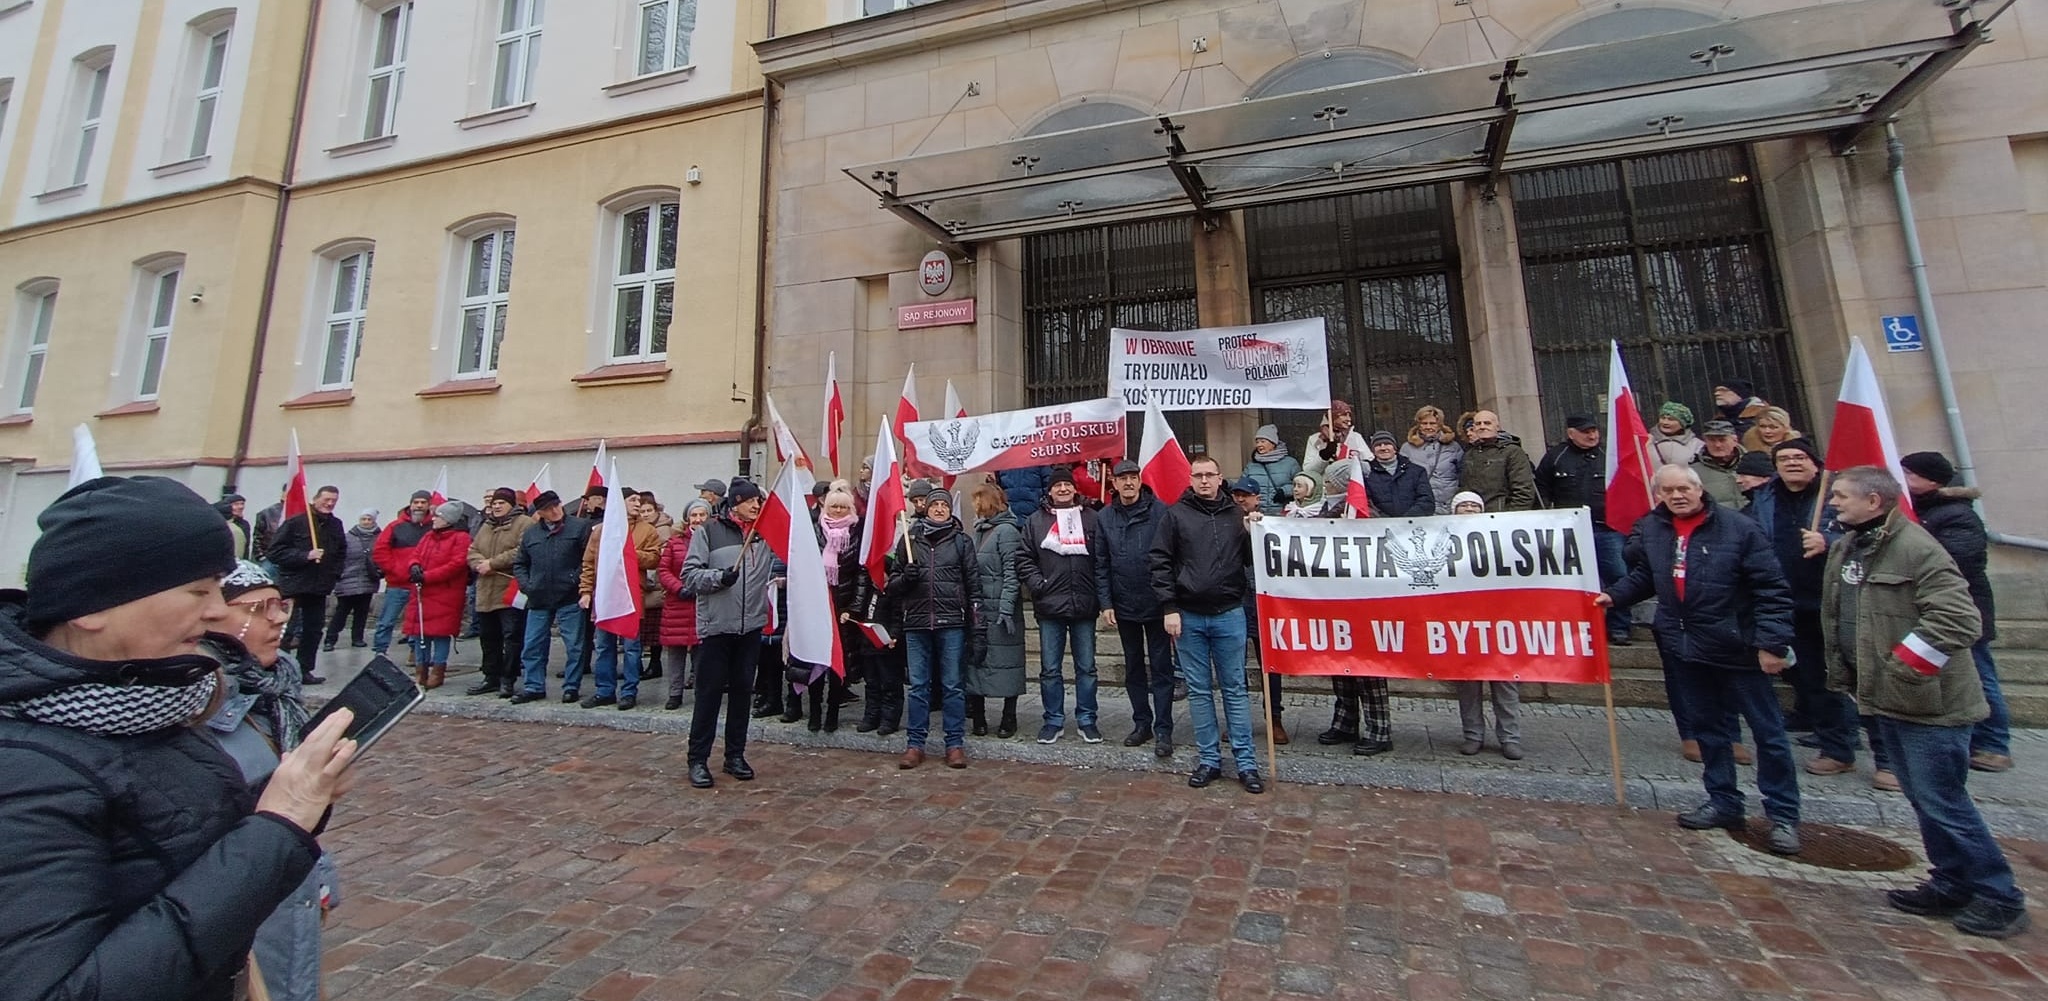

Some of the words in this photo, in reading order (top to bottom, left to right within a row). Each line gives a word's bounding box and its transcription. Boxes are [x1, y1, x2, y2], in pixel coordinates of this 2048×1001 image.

[904, 312, 920, 322] SĄD
[923, 307, 967, 319] REJONOWY
[1126, 338, 1137, 355] W
[1141, 338, 1197, 357] OBRONIE
[1219, 333, 1257, 351] PROTEST
[1222, 342, 1290, 370] WOLNYCH
[1124, 363, 1208, 381] TRYBUNAŁU
[1244, 360, 1288, 381] POLAKÓW
[1035, 411, 1073, 428] KLUB
[991, 430, 1046, 449] GAZETY
[1052, 421, 1119, 440] POLSKIEJ
[1031, 442, 1081, 458] SŁUPSK
[1263, 533, 1398, 578] GAZETA
[1447, 528, 1583, 578] POLSKA
[1269, 618, 1353, 651] KLUB
[1371, 620, 1405, 653] W
[1426, 620, 1594, 657] BYTOWIE
